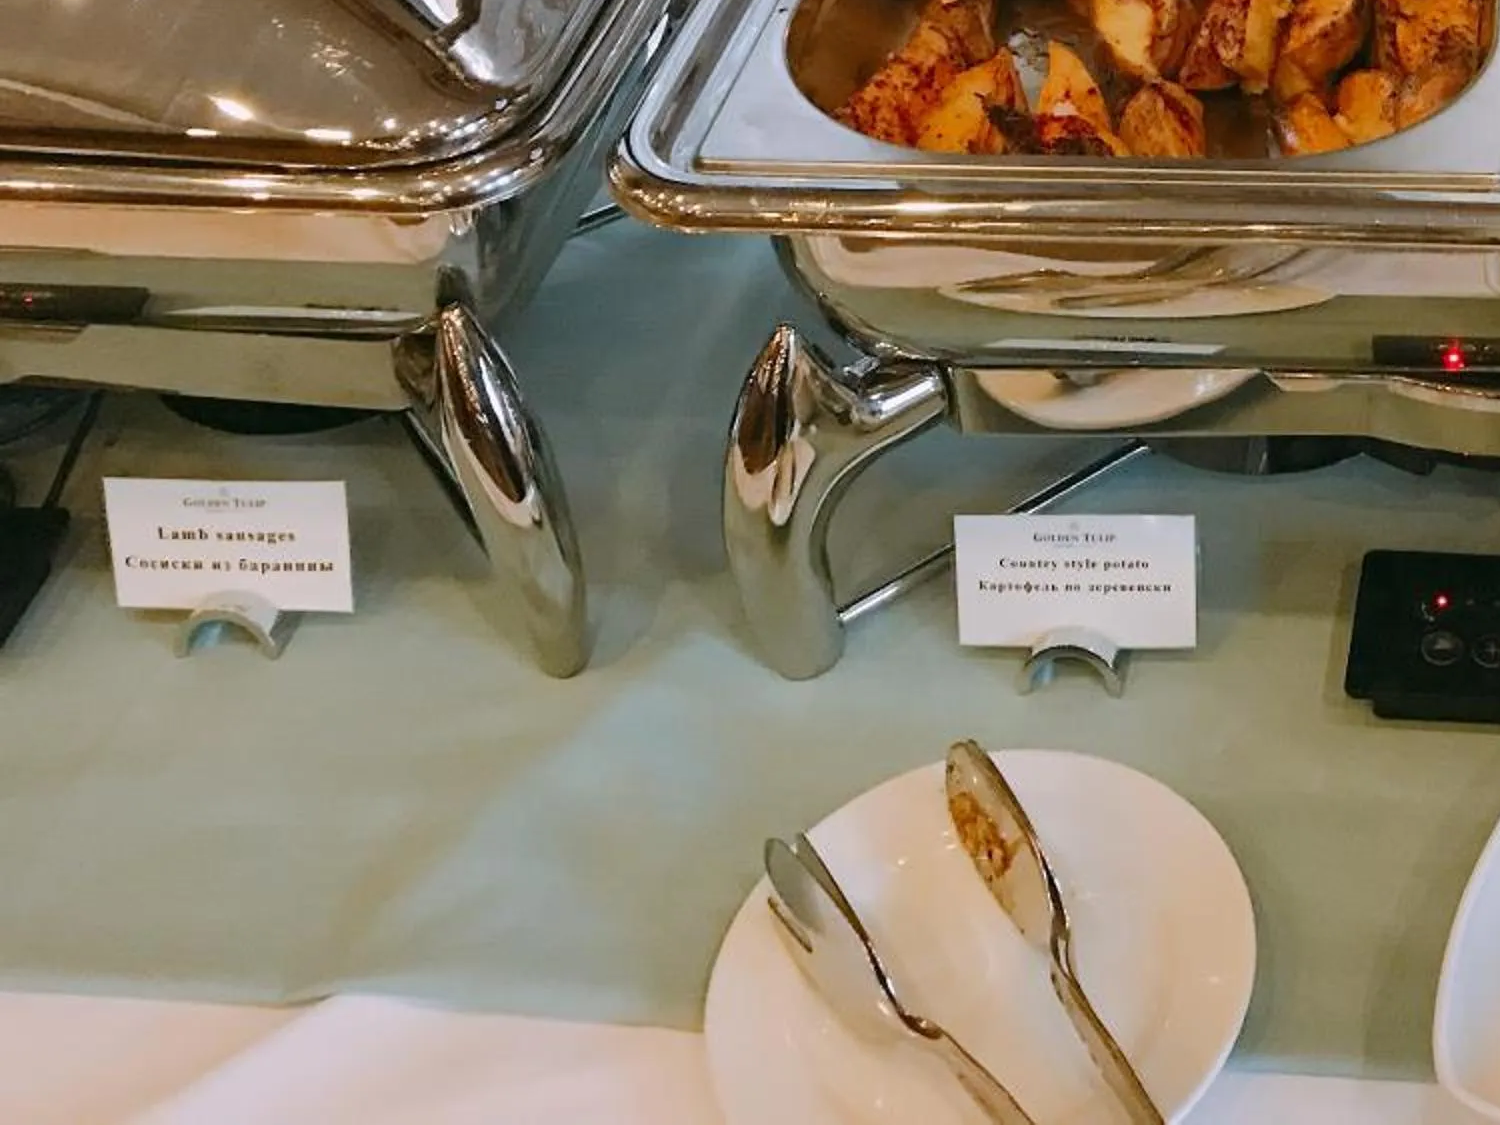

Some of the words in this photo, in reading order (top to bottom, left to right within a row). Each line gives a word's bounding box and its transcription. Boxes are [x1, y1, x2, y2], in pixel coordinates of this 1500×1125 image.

[158, 526, 209, 540] Lamb
[216, 532, 295, 544] sausages
[125, 556, 203, 570] Сосиски
[211, 561, 231, 572] из
[239, 558, 334, 575] баранины
[999, 558, 1057, 573] Country
[1064, 558, 1097, 572] style
[1103, 560, 1149, 571] potato
[979, 580, 1059, 593] Картофель
